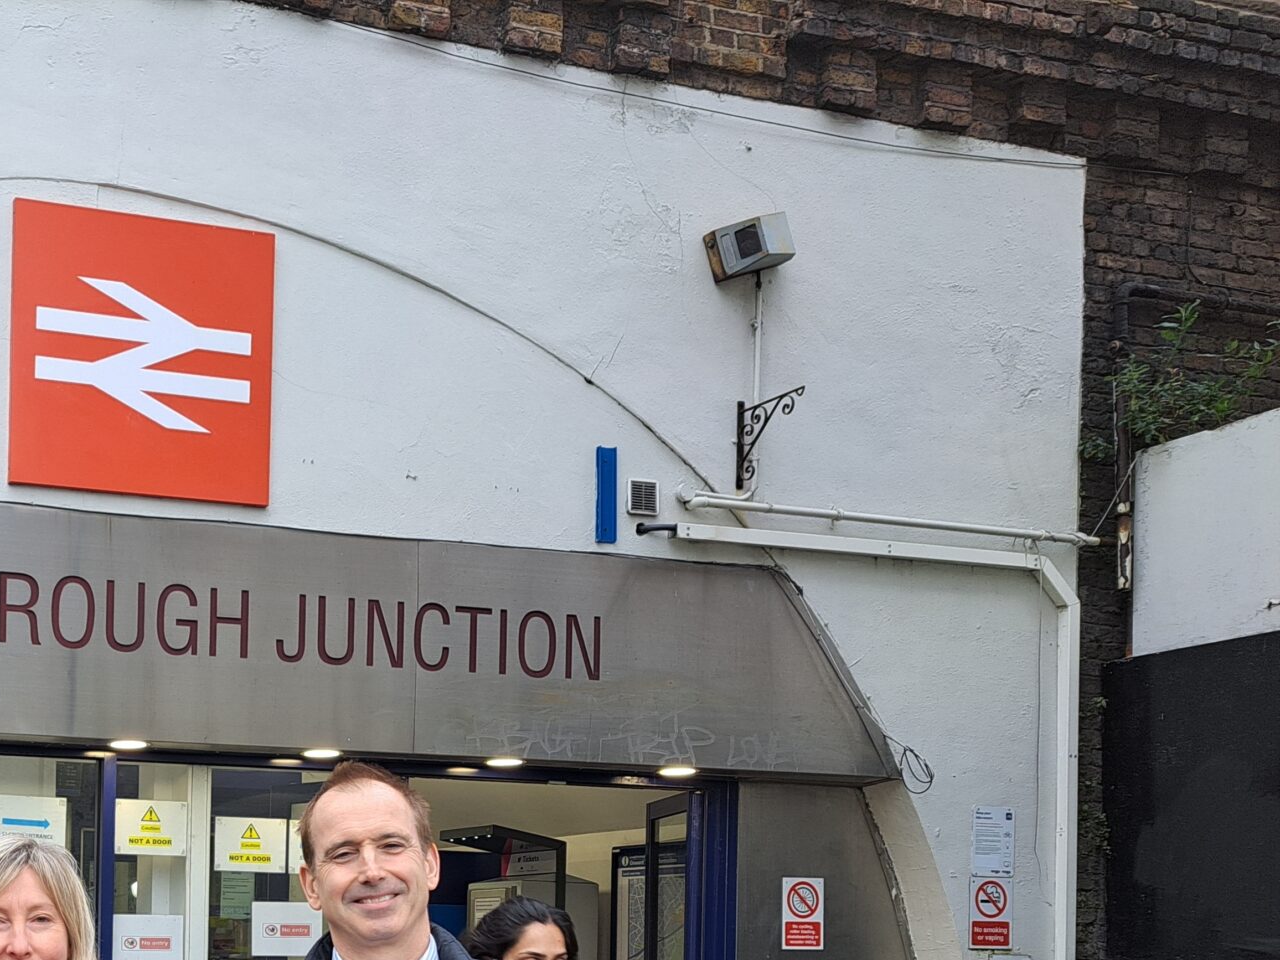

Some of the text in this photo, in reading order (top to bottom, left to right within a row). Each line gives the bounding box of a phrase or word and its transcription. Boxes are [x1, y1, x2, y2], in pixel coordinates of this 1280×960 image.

[276, 594, 601, 681] JUNCTION
[292, 927, 309, 935] entry
[983, 927, 1008, 935] smoking
[152, 940, 170, 948] entry
